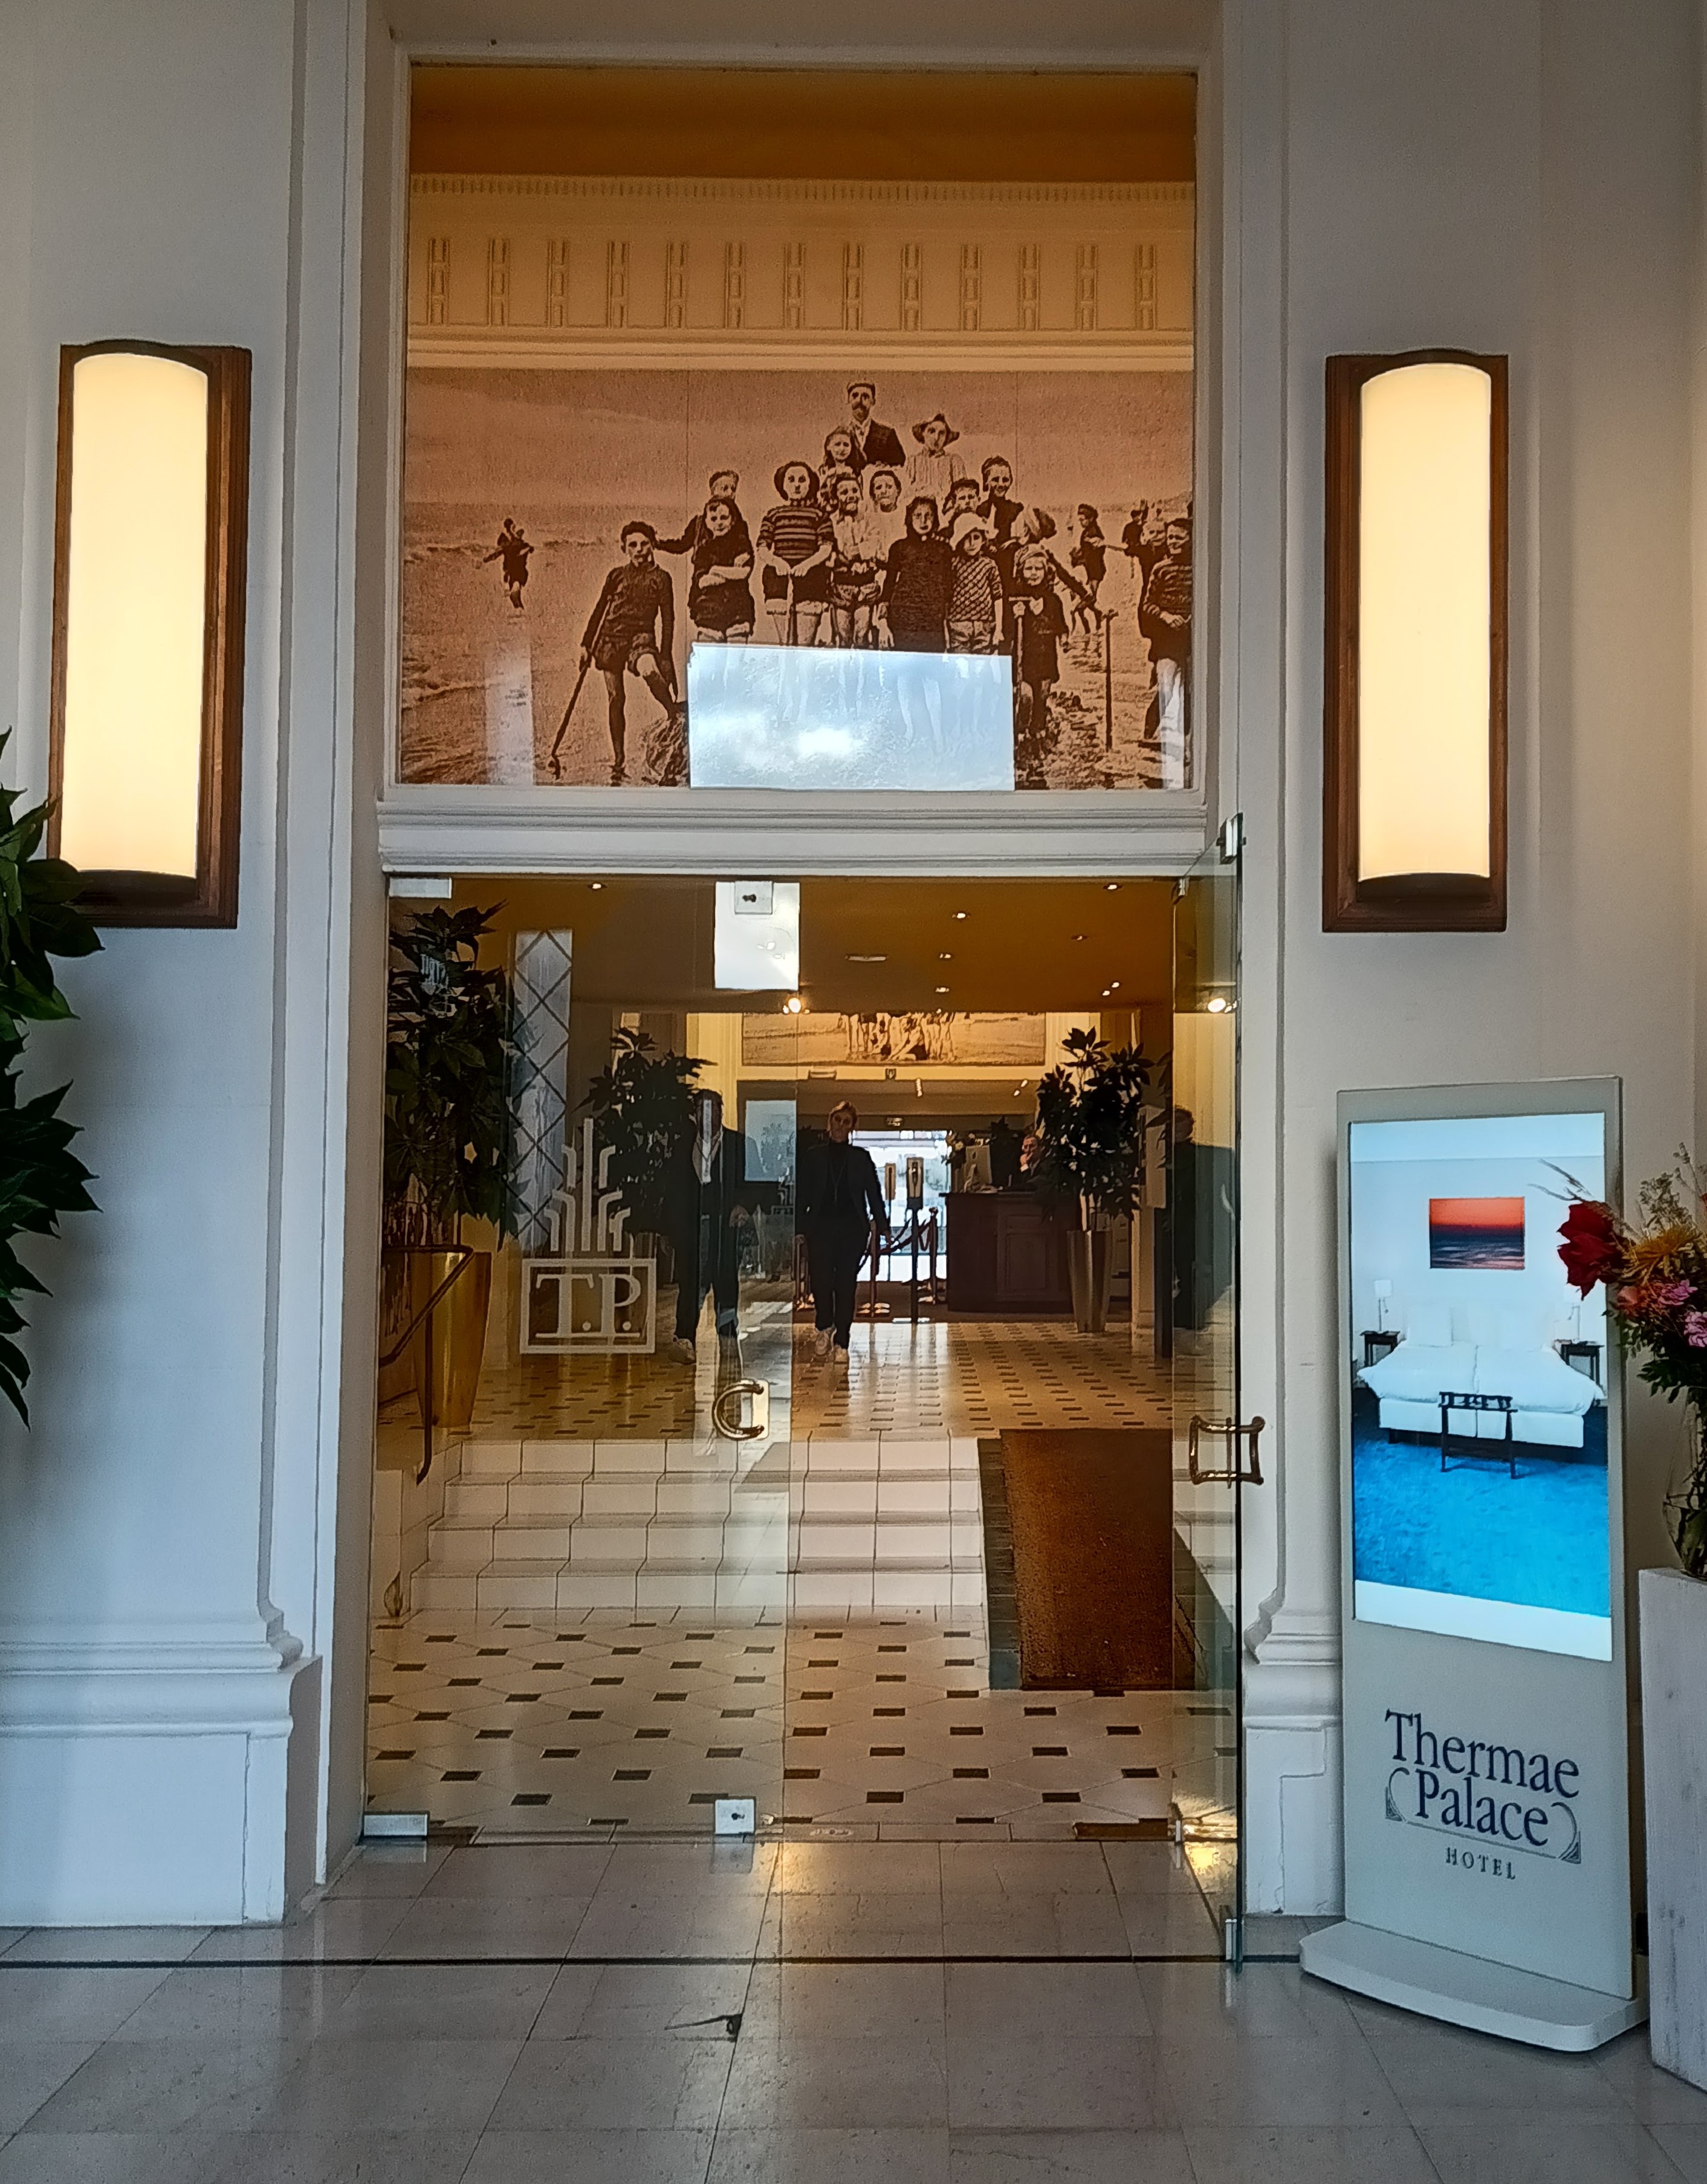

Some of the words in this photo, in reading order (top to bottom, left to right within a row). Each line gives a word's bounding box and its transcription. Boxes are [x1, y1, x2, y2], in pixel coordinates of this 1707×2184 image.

[1385, 1708, 1579, 1798] Thermae
[1415, 1768, 1549, 1846] Palace
[1445, 1847, 1516, 1880] HOTEL
